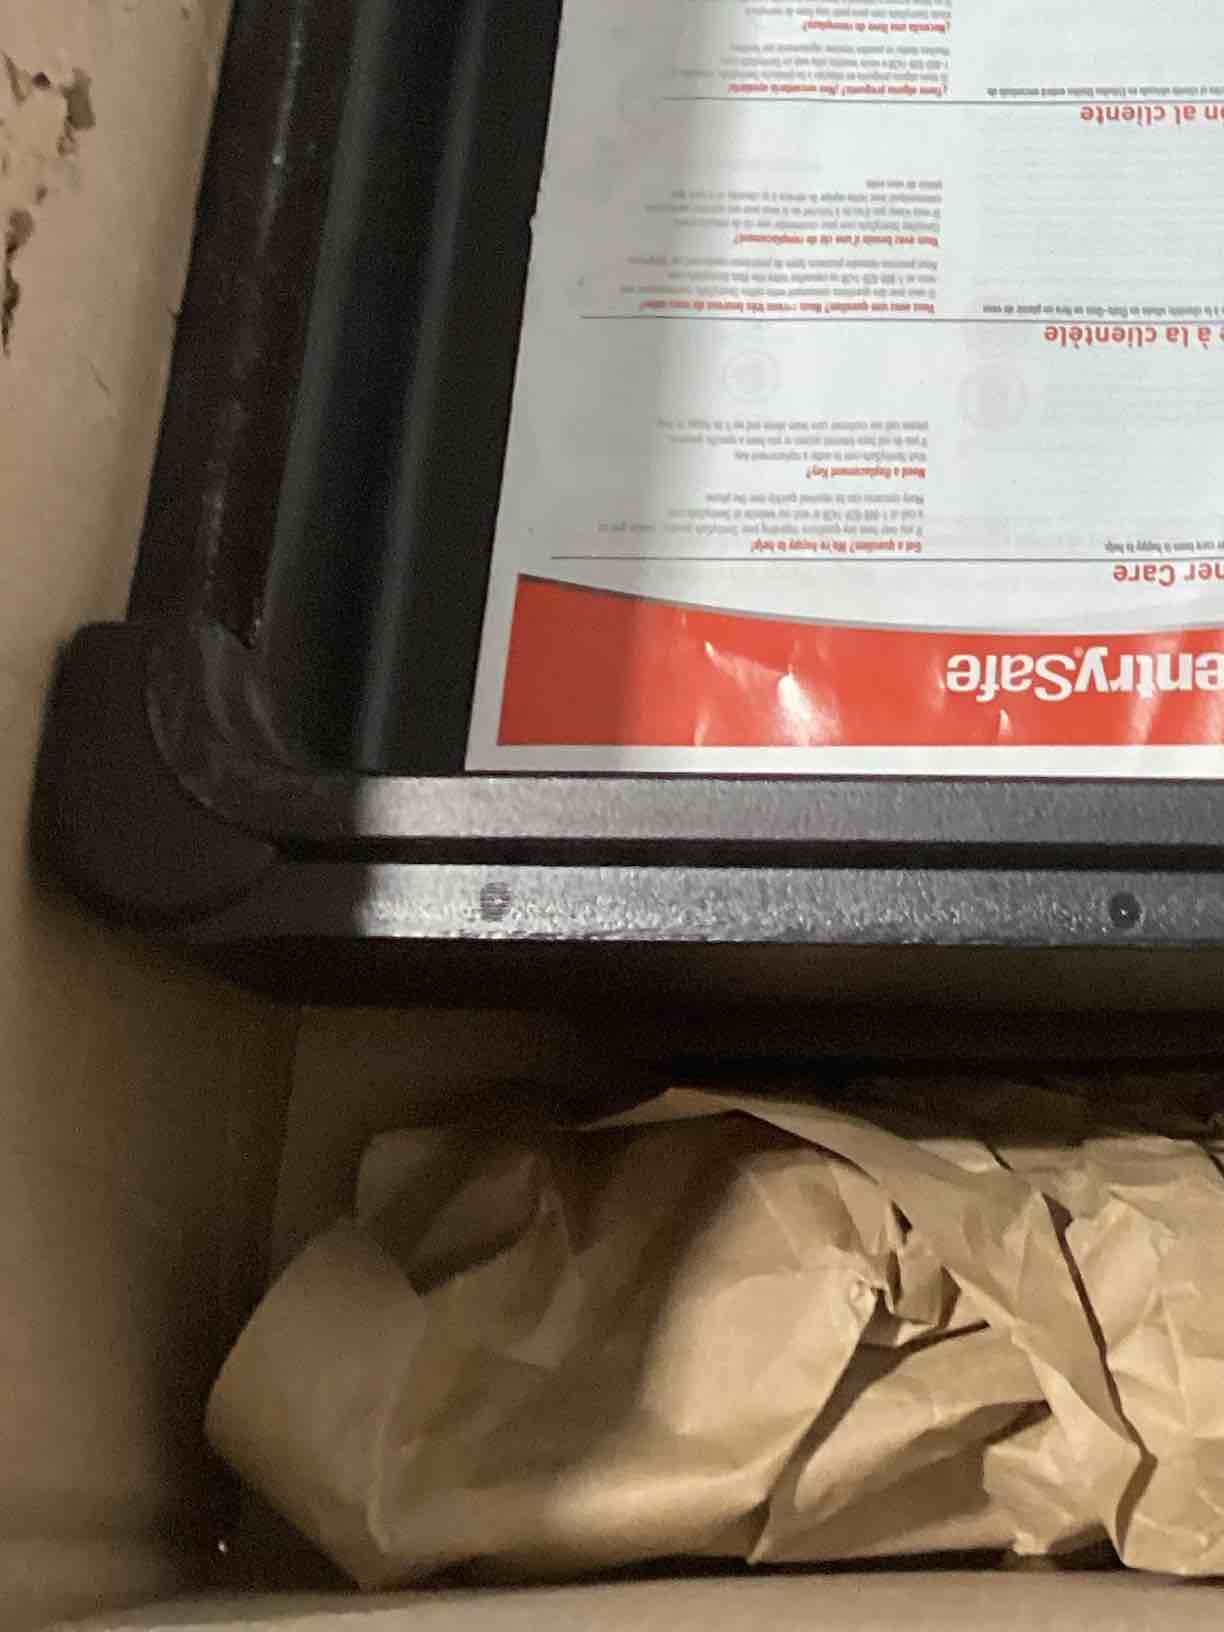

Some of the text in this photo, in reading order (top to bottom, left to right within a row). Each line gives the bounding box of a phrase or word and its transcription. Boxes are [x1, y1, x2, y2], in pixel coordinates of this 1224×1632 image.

[1079, 104, 1166, 126] cliente
[1174, 104, 1197, 126] al
[1043, 325, 1158, 349] clientèle
[1166, 325, 1189, 349] la
[1197, 326, 1212, 350] à
[1113, 564, 1175, 587] Care
